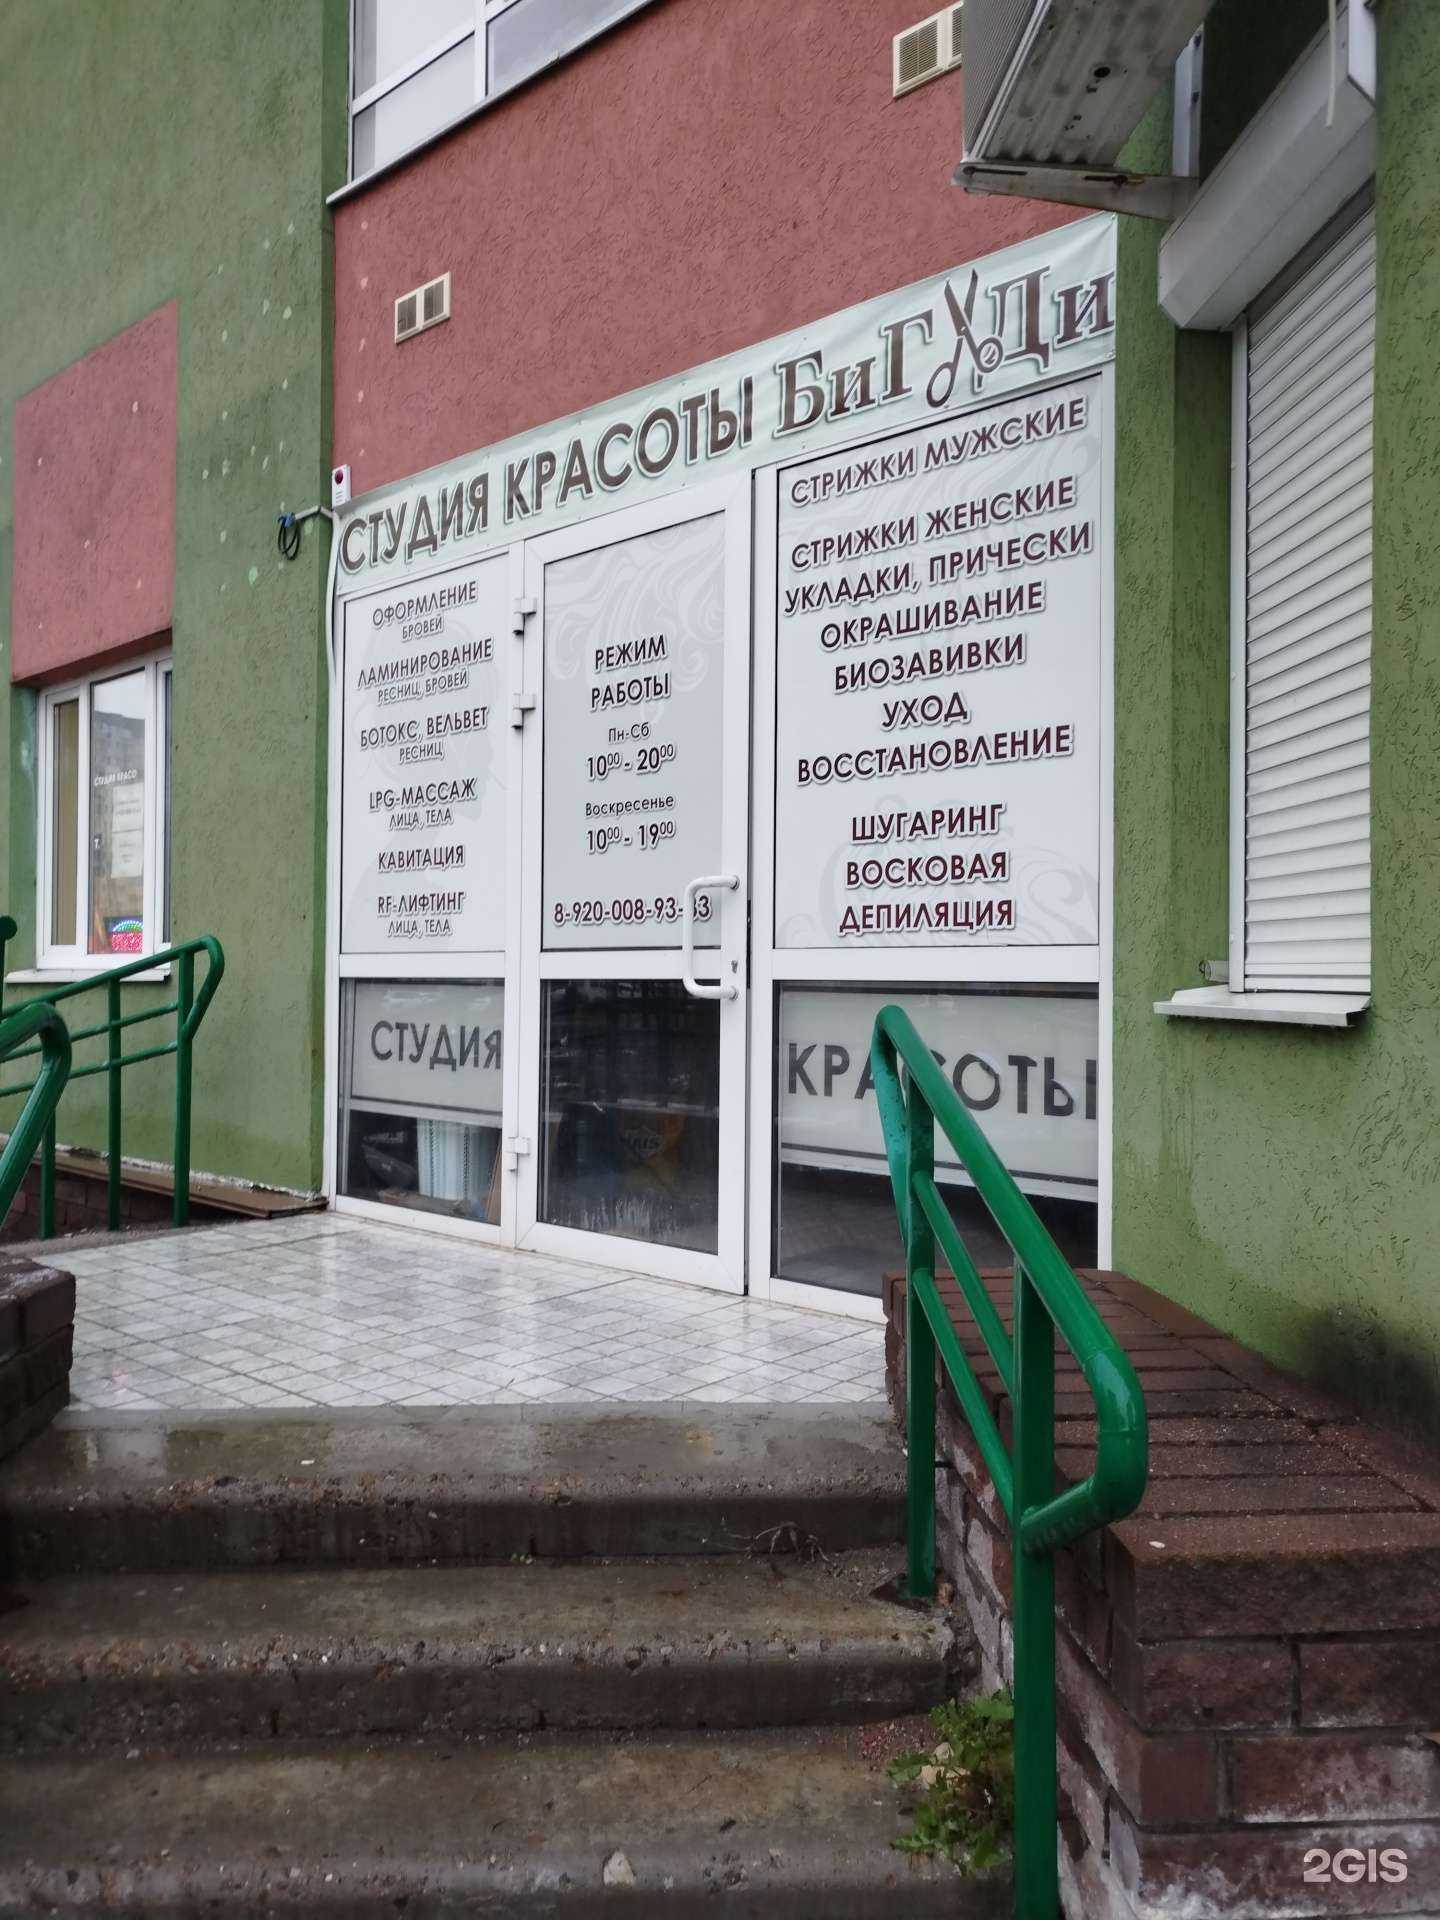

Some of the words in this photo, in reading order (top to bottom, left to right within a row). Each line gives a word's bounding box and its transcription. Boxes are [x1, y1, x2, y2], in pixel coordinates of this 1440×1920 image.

[792, 448, 915, 504] СТРИЖКИ
[924, 399, 1087, 468] МУЖСКИЕ
[341, 472, 490, 571] СТУДИЯ
[505, 376, 754, 521] КРАСОТЫ
[792, 516, 916, 569] СТРИЖКИ
[926, 476, 1075, 536] ЖЕНСКИЕ
[784, 562, 918, 614] УКЛАДКИ,
[929, 521, 1091, 582] ПРИЧЕСКИ
[373, 581, 477, 626] ОФОРМЛЕНИЕ
[821, 581, 1043, 648] ОКРАШИВАНИЕ
[402, 618, 442, 639] БРОВЕЙ
[358, 638, 492, 686] ЛАМИНИРОВАНИЕ
[595, 634, 666, 670] РЕЖИМ
[835, 633, 1024, 690] БИОЗАВИВКИ
[425, 671, 467, 691] БРОВЕЙ
[591, 673, 669, 708] РАБОТЫ
[360, 720, 423, 747] БОТОКС,
[427, 706, 487, 735] ВЕЛЬВЕТ
[882, 692, 968, 728] УХОД
[608, 722, 650, 742] Пн-Сб
[400, 743, 443, 761] РЕСНИЦ
[798, 724, 1072, 783] ВОССТАНОВЛЕНИЕ
[369, 777, 477, 809] LPG-МАССАЖ
[585, 794, 675, 817] Воскресенье
[389, 812, 423, 830] ЛИЦА,
[426, 807, 452, 823] ТЕЛА
[852, 803, 1003, 841] ШУГАРИНГ
[378, 845, 464, 870] КАВИТАЦИЯ
[847, 851, 1008, 886] ВОСКОВАЯ
[377, 892, 464, 914] RF-ЛИФТИНГ
[839, 899, 1013, 934] ДЕПИЛЯЦИЯ
[388, 920, 422, 935] ЛИЦА,
[425, 918, 451, 933] ТЕЛА
[370, 1020, 501, 1072] СТУДИЯ
